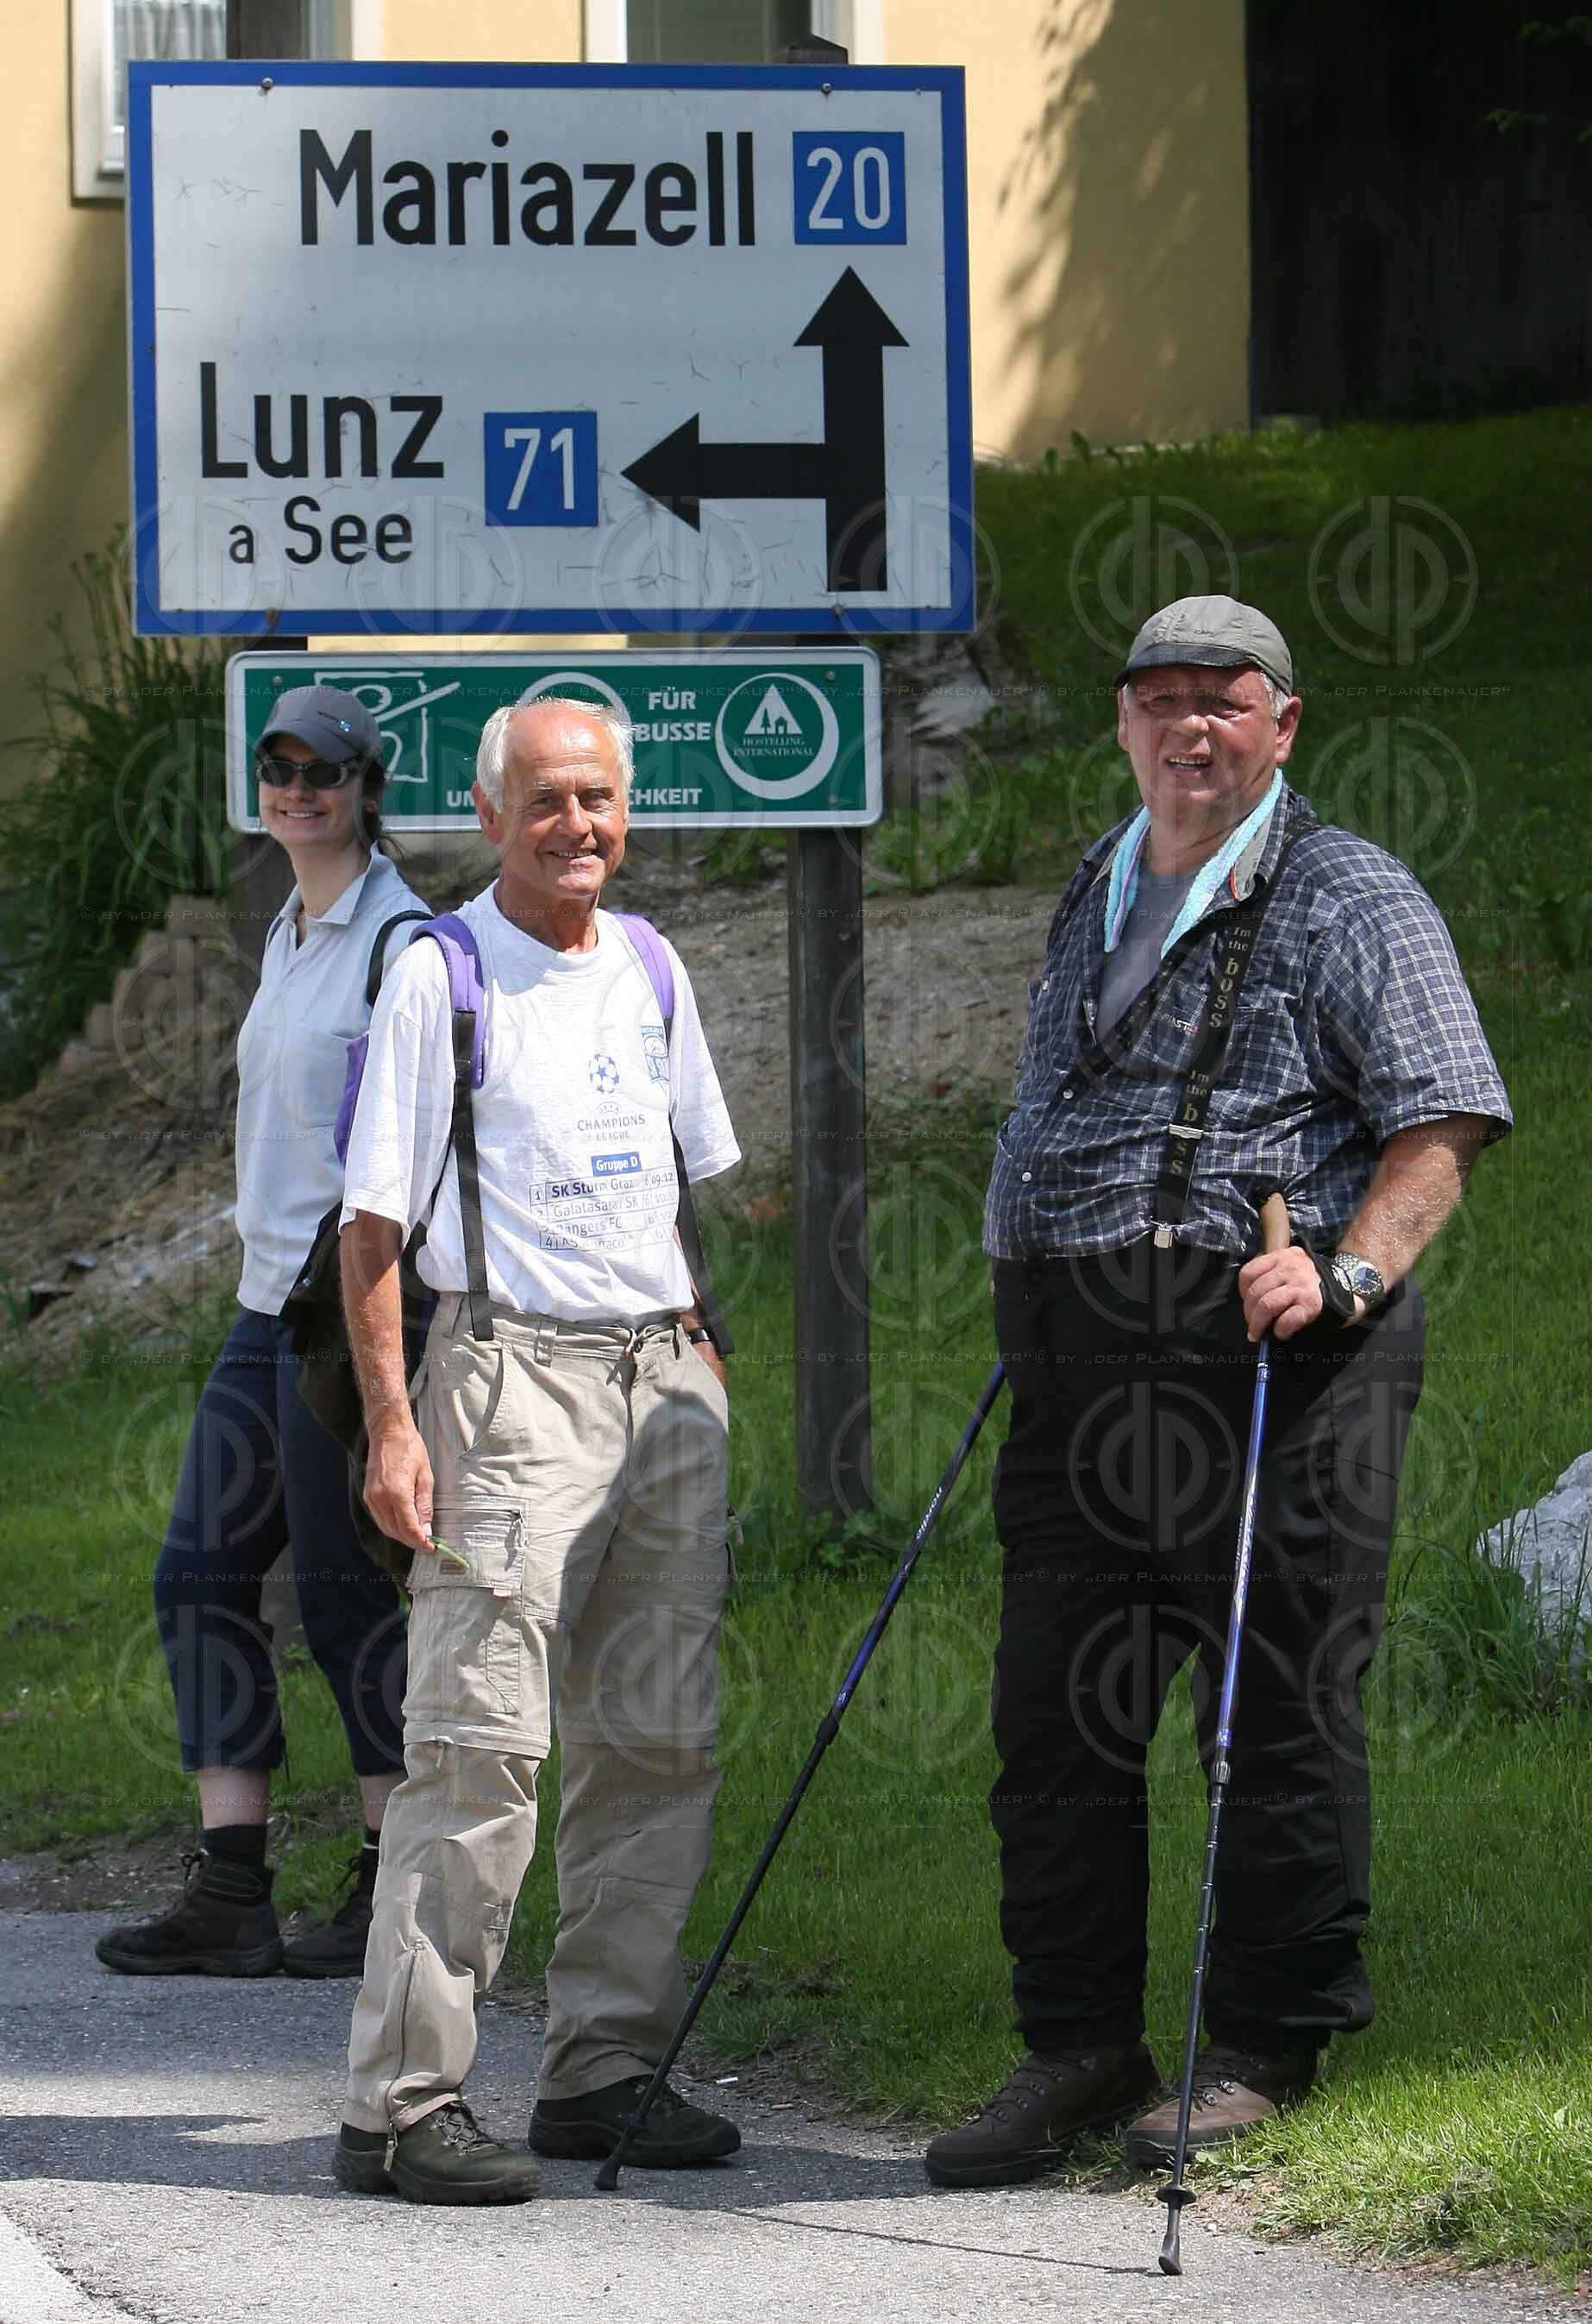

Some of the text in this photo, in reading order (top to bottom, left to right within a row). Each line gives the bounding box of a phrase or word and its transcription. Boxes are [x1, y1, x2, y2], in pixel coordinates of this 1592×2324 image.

[300, 129, 892, 247] Mariazell 20
[200, 362, 575, 511] Lunz 71
[229, 495, 412, 565] a See
[649, 687, 696, 711] FÜR
[635, 722, 711, 742] BUSSE
[743, 738, 805, 746] HOSTELLING
[733, 748, 814, 757] INTERNATIONAL
[1229, 940, 1249, 952] the
[1209, 957, 1239, 1028] boss
[577, 1113, 646, 1132] CHAMPIONS
[595, 1156, 638, 1173] Gruppe D
[535, 1190, 541, 1200] 1
[551, 1184, 571, 1198] SK
[573, 1181, 608, 1195] Sturm
[611, 1178, 636, 1191] Graz
[625, 1195, 639, 1209] SK
[609, 1216, 622, 1229] FC
[545, 1235, 553, 1248] 4
